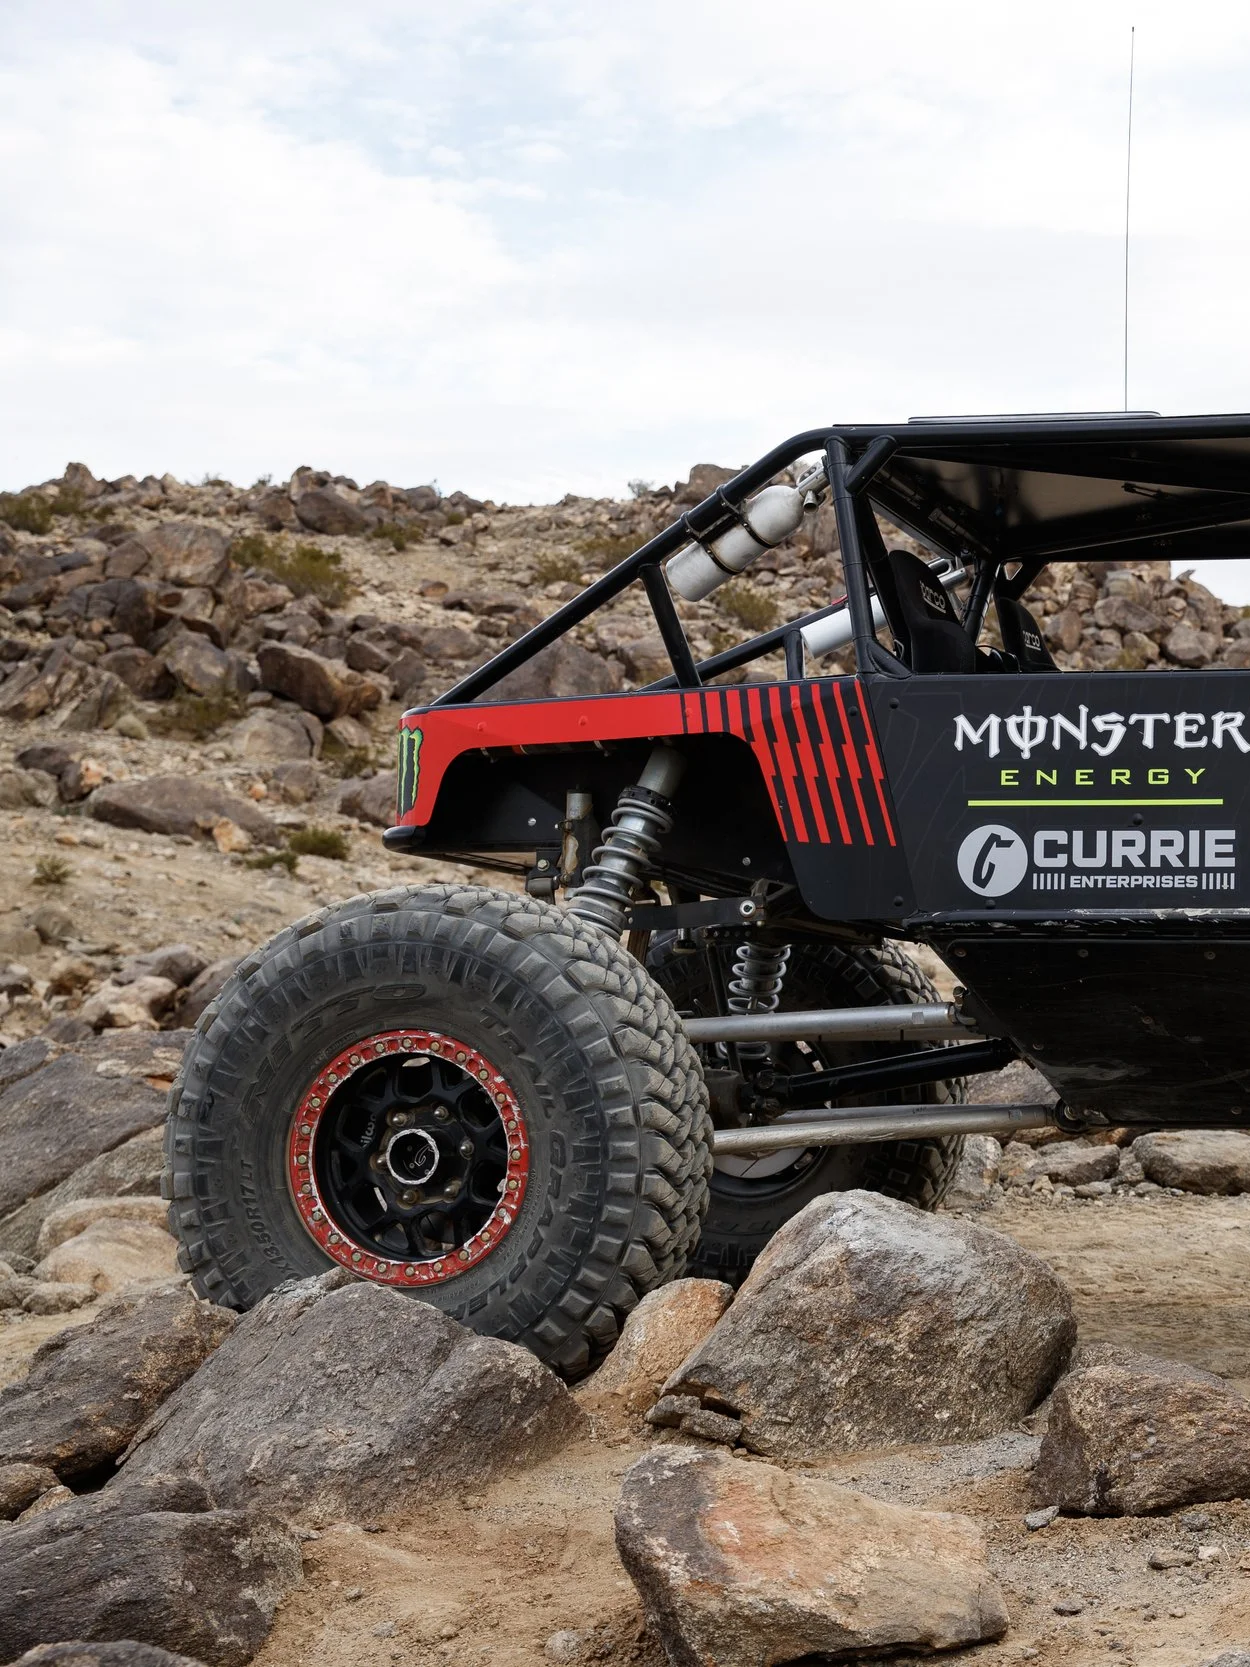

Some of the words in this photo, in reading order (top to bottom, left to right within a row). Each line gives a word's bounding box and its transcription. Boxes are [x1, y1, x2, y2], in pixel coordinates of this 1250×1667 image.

[1001, 768, 1206, 786] ENERGY
[1034, 830, 1236, 868] CURRIE
[1070, 875, 1198, 888] ENTERPRISES
